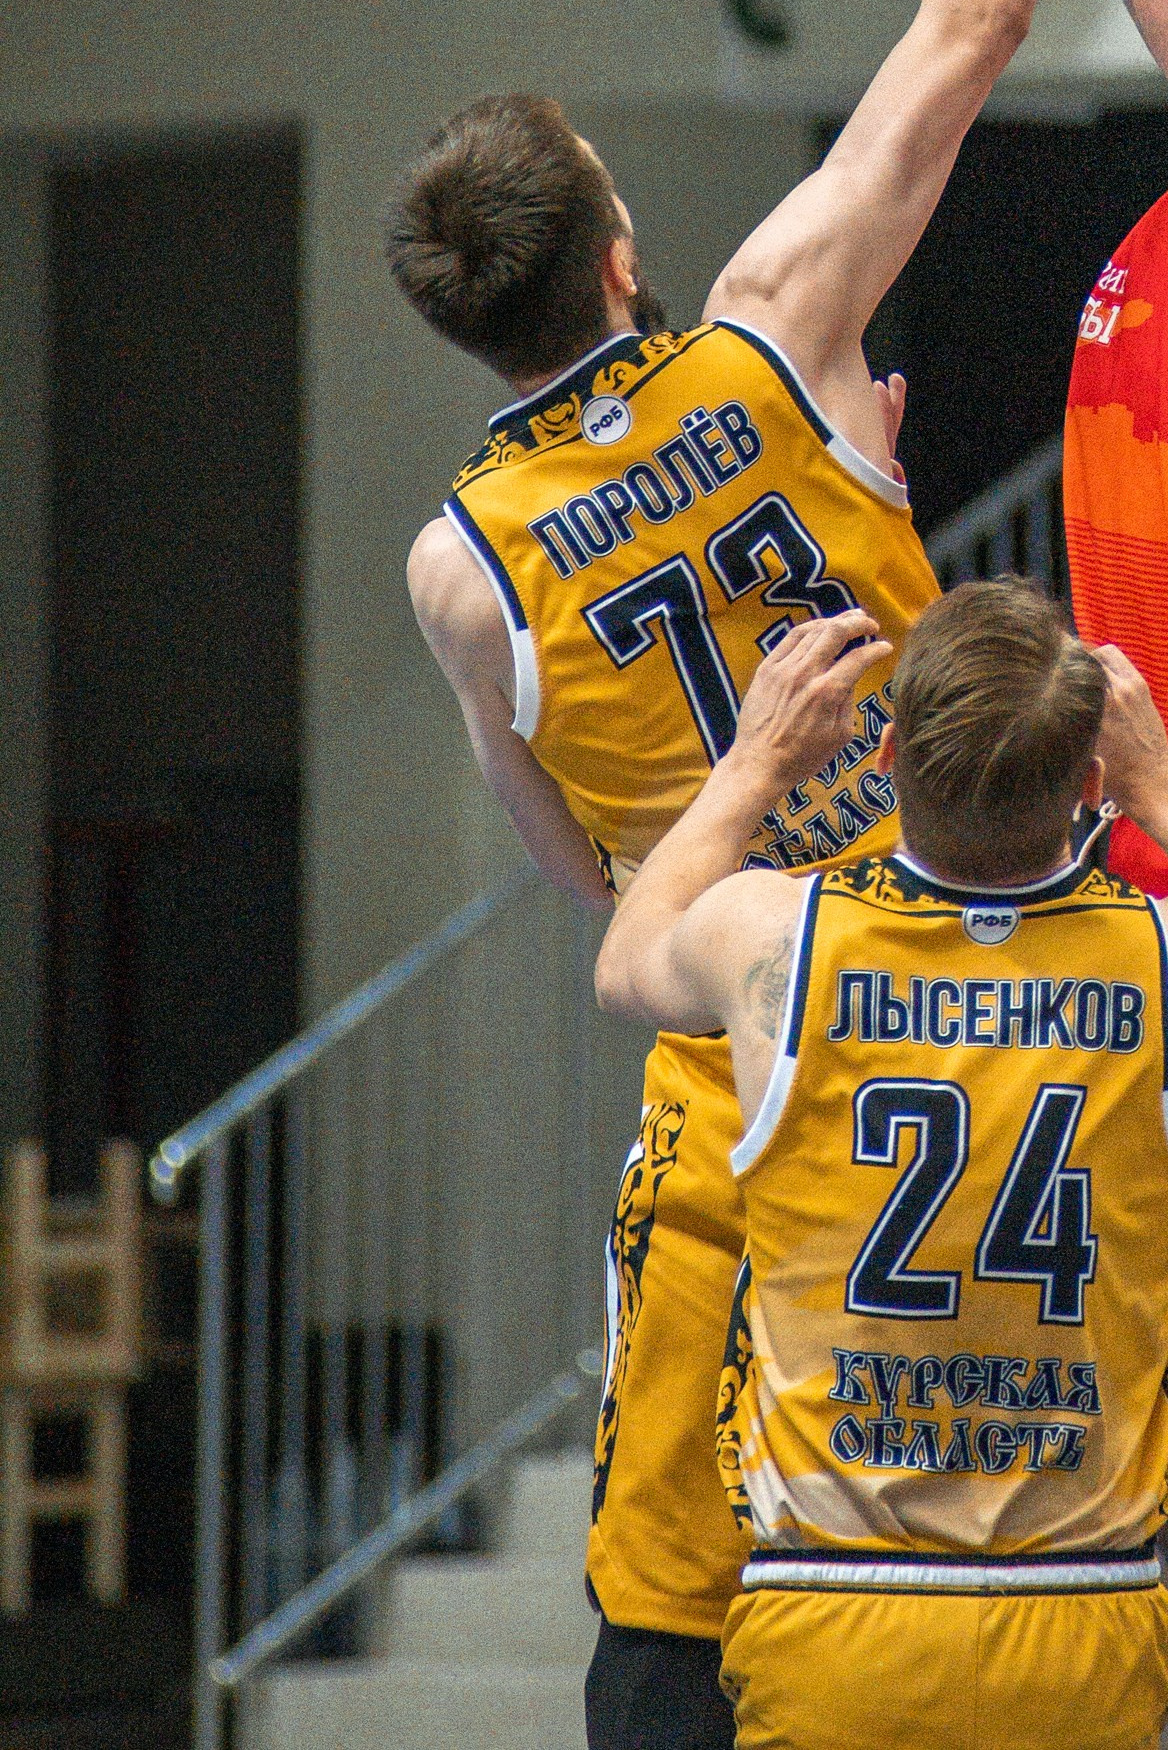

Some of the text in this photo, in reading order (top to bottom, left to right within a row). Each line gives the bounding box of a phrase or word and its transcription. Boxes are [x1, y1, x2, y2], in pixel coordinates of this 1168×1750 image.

[589, 405, 623, 437] РФБ
[527, 400, 763, 580] ПОРОЛЁВ
[581, 491, 878, 771] 73
[971, 913, 1012, 928] РФБ
[828, 969, 1145, 1054] ЛЫСЕНКОВ
[844, 1076, 1099, 1326] 24
[829, 1349, 1102, 1419] КУРСКАЯ
[829, 1417, 1087, 1474] ОБЛАСТЬ
